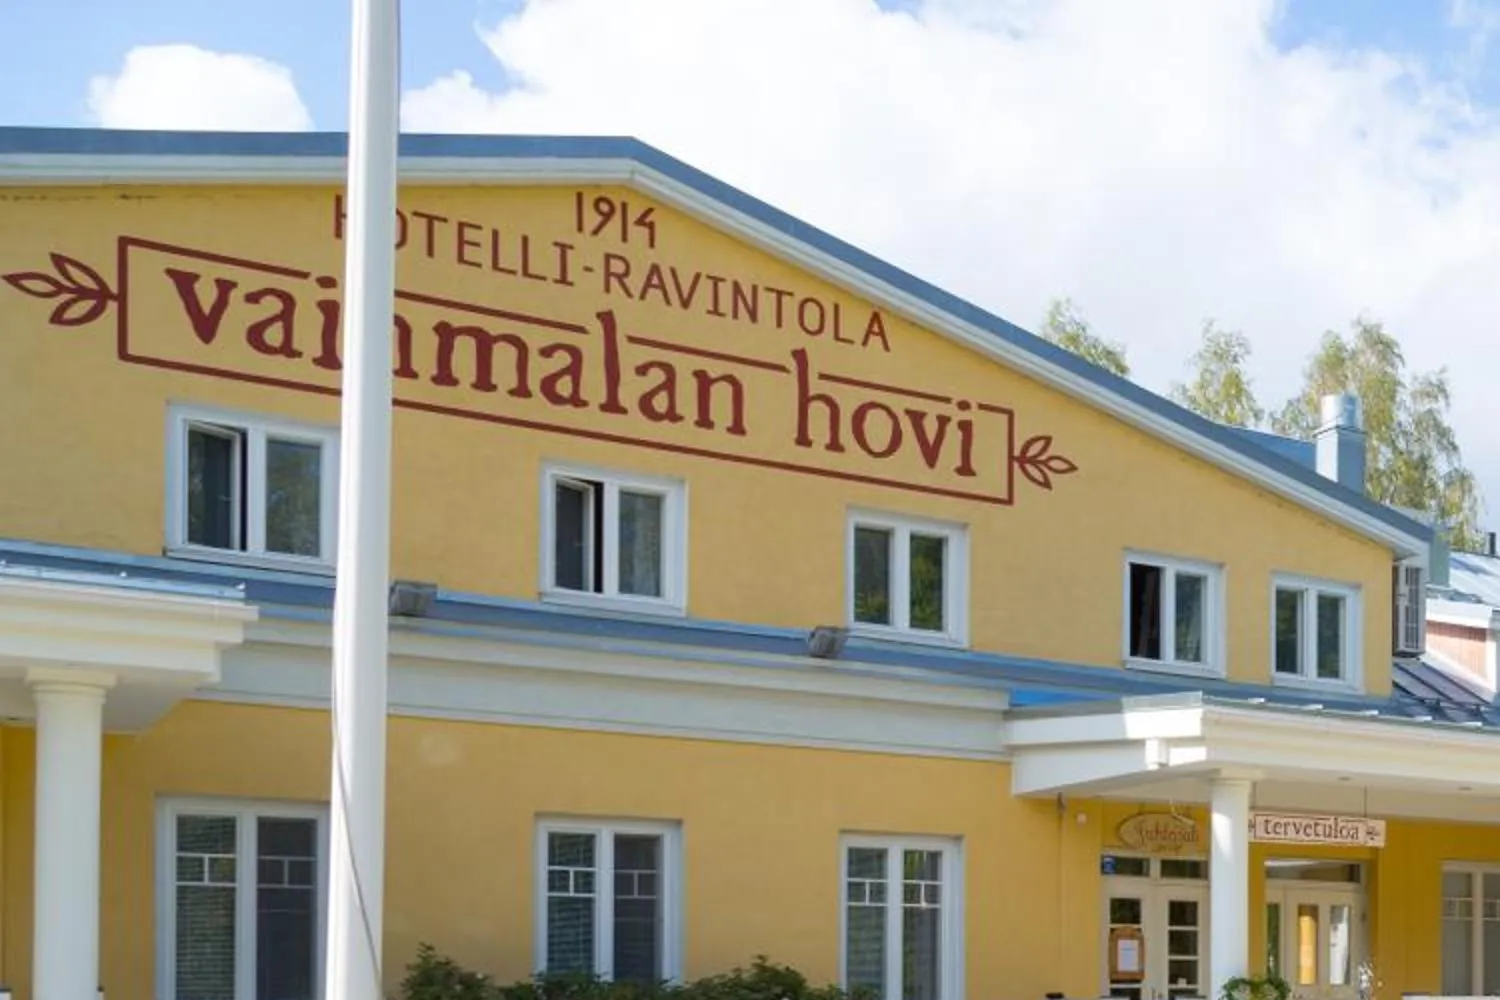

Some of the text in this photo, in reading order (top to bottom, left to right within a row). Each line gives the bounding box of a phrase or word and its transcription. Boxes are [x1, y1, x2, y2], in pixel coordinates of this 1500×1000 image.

[575, 191, 656, 249] 1914
[791, 347, 977, 477] hovi
[1263, 816, 1360, 840] tervetuloa
